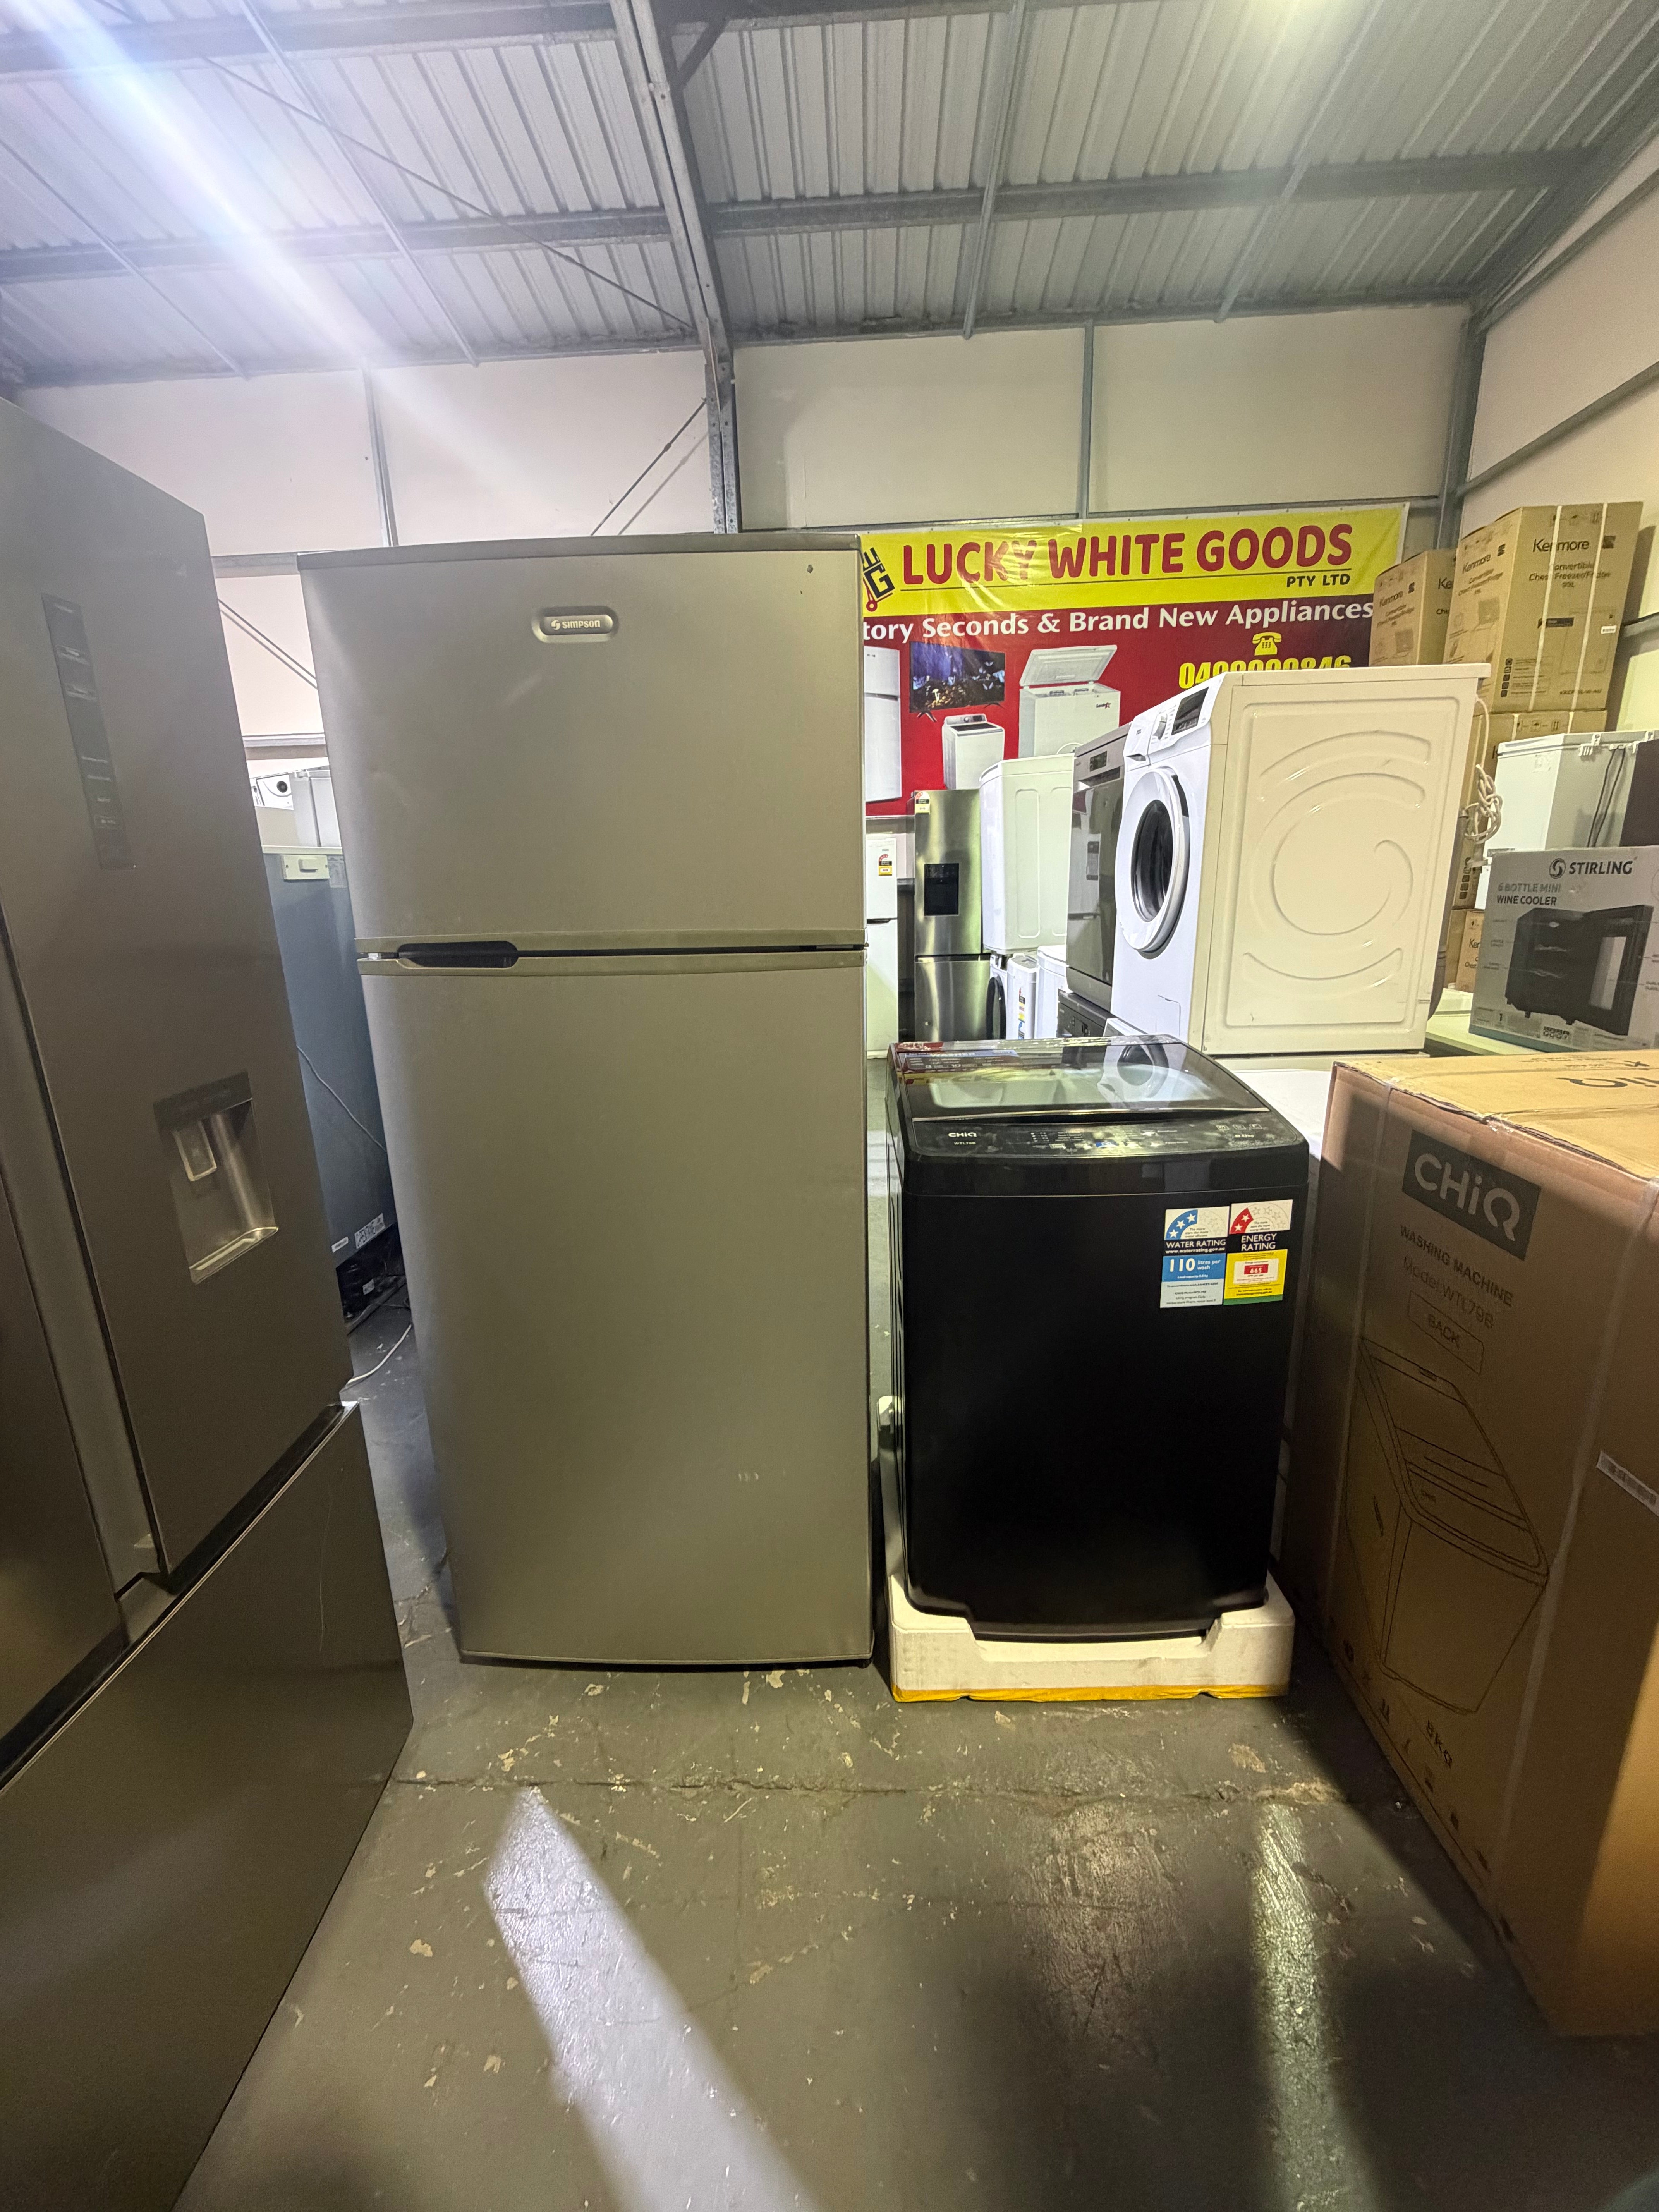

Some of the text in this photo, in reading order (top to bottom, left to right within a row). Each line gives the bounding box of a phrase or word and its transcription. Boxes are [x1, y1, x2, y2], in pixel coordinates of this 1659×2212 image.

[903, 524, 1352, 584] LUCKY WHITE GOODS
[1287, 574, 1350, 588] PTY LTD
[922, 613, 1029, 638] Seconds
[1037, 613, 1060, 634] &
[1070, 607, 1149, 632] Brand
[1159, 607, 1218, 628] New
[1225, 600, 1374, 629] Appliances
[1569, 861, 1633, 875] STIRLING
[1504, 883, 1539, 892] BOTTLE
[1540, 883, 1561, 893] MINI
[1497, 895, 1557, 905] WINE COOLER
[1415, 1153, 1520, 1242] CHiQ
[1241, 1233, 1277, 1243] ENERGY
[1241, 1242, 1276, 1252] RATING
[1170, 1258, 1195, 1272] 110
[1400, 1224, 1513, 1307] WASHING MACHINE
[1428, 1314, 1460, 1350] BACK
